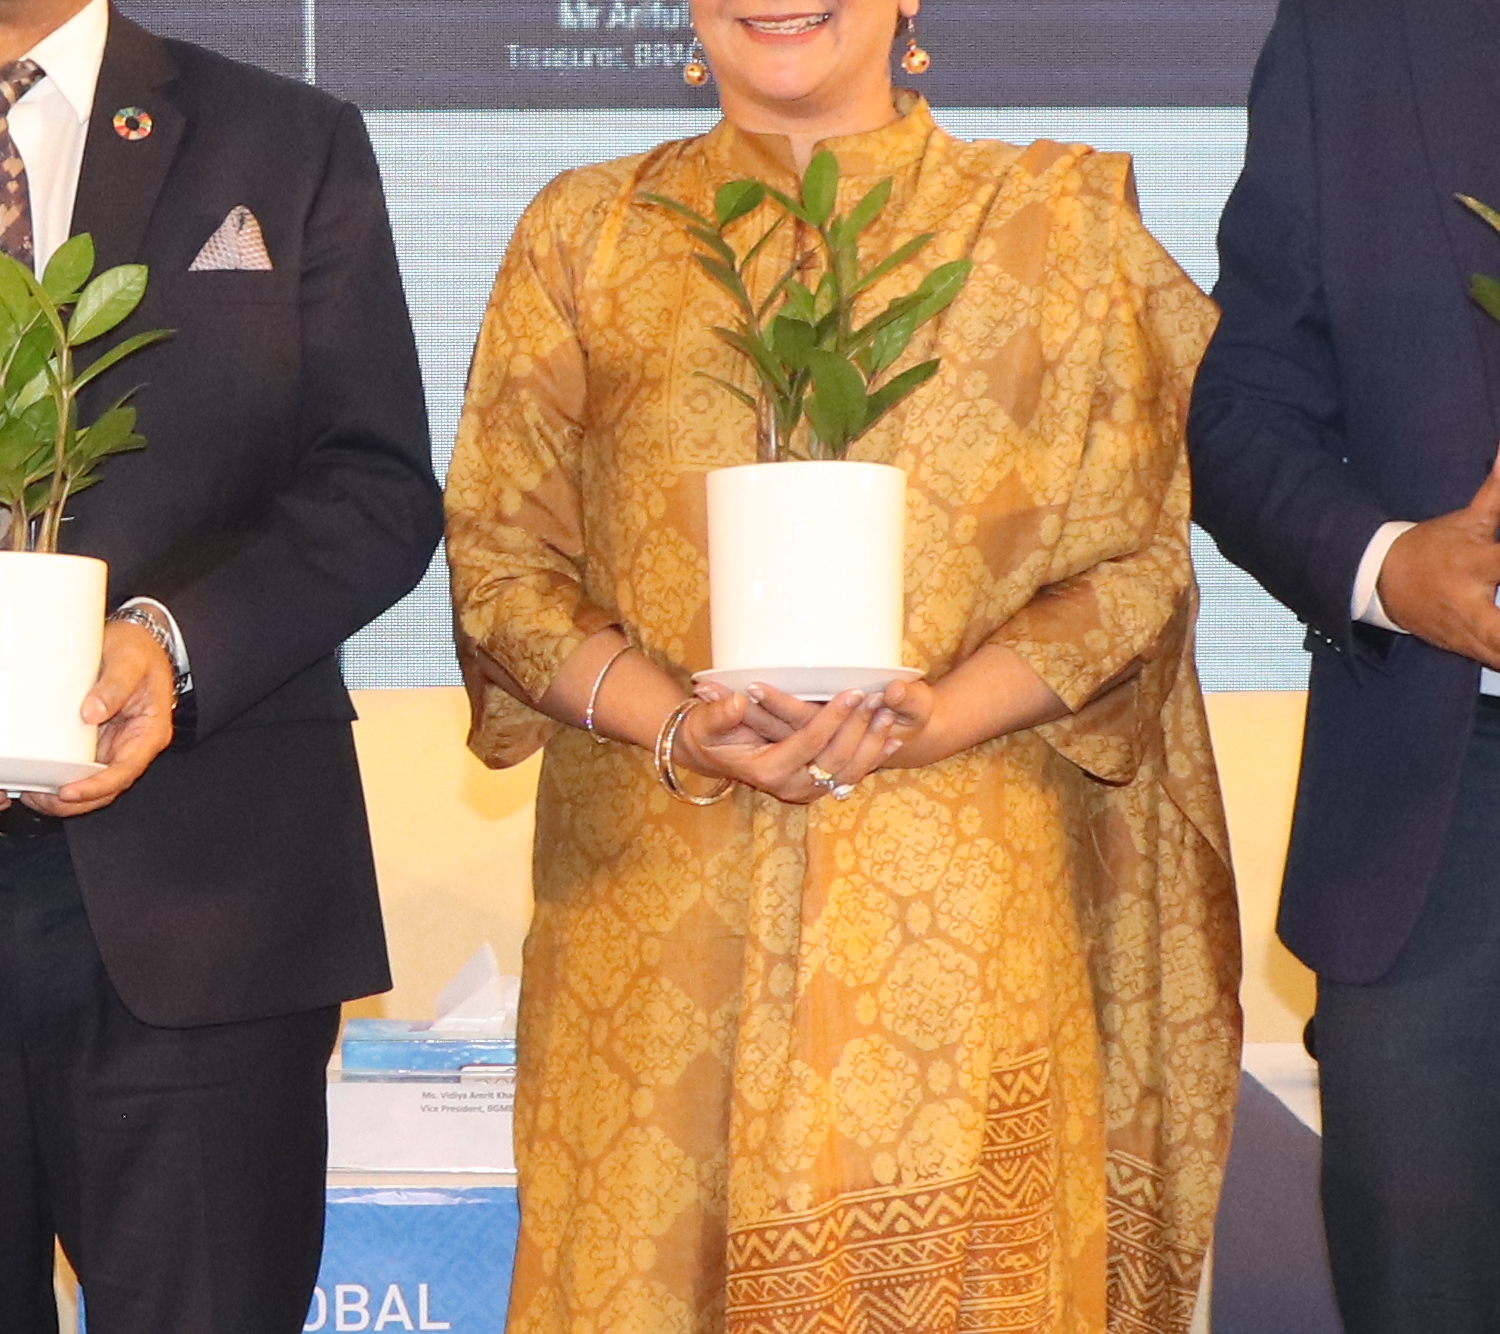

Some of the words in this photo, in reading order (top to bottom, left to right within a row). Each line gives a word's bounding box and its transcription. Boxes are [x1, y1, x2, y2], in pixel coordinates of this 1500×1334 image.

[559, 0, 599, 29] Mr
[422, 1091, 437, 1100] Ms.
[441, 1091, 467, 1101] Vidiya
[469, 1091, 494, 1100] Amrit
[497, 1091, 514, 1100] Kha
[421, 1105, 439, 1113] Vice
[441, 1105, 484, 1114] President,
[301, 1283, 450, 1331] OBAL
